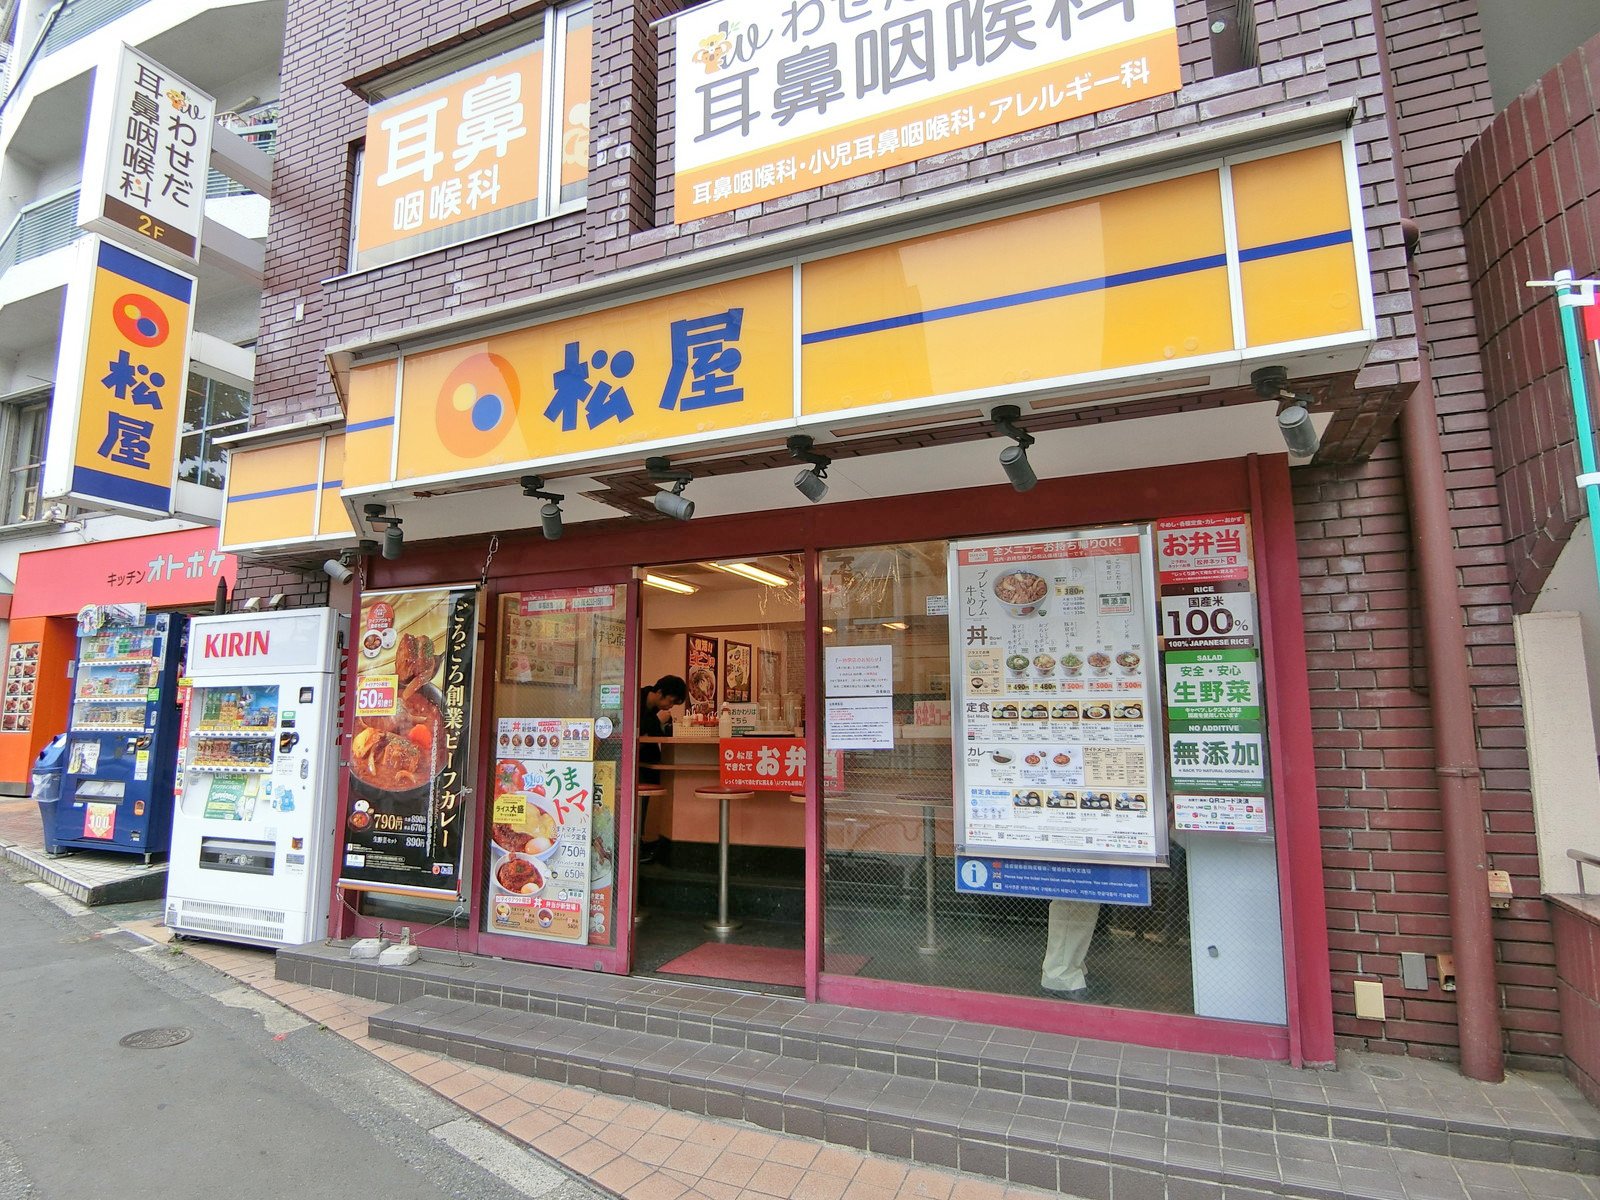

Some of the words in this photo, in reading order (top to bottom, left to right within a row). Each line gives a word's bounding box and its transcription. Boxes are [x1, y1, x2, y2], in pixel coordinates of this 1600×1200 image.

[120, 62, 165, 208] 耳鼻咽喉科
[376, 72, 527, 187] 耳鼻
[691, 56, 1150, 205] 耳鼻咽喉科・小児耳鼻咽喉科・アレルギー科
[161, 115, 197, 208] わせだ
[393, 164, 501, 231] 咽喉科
[138, 214, 165, 240] 2F
[543, 308, 744, 432] 松屋
[97, 349, 165, 470] 松屋
[1162, 529, 1241, 557] お弁当
[107, 570, 146, 587] キッチン
[147, 549, 226, 583] オトボケ
[965, 585, 977, 617] 牛めし
[978, 569, 988, 616] プレミアム
[1188, 596, 1224, 608] 国産米
[967, 625, 988, 645] 丼
[1167, 608, 1249, 635] 100%
[205, 630, 271, 658] KIRIN
[1190, 639, 1230, 647] JAPANESE
[1180, 665, 1242, 677] 安全・安心
[1173, 680, 1251, 703] 生野菜
[966, 702, 990, 713] 定食
[440, 602, 468, 848] ごろごろ創業ビーフカレー
[968, 747, 994, 756] カレー
[1173, 740, 1260, 766] 無添加
[90, 815, 109, 829] 100
[561, 845, 586, 858] 750円
